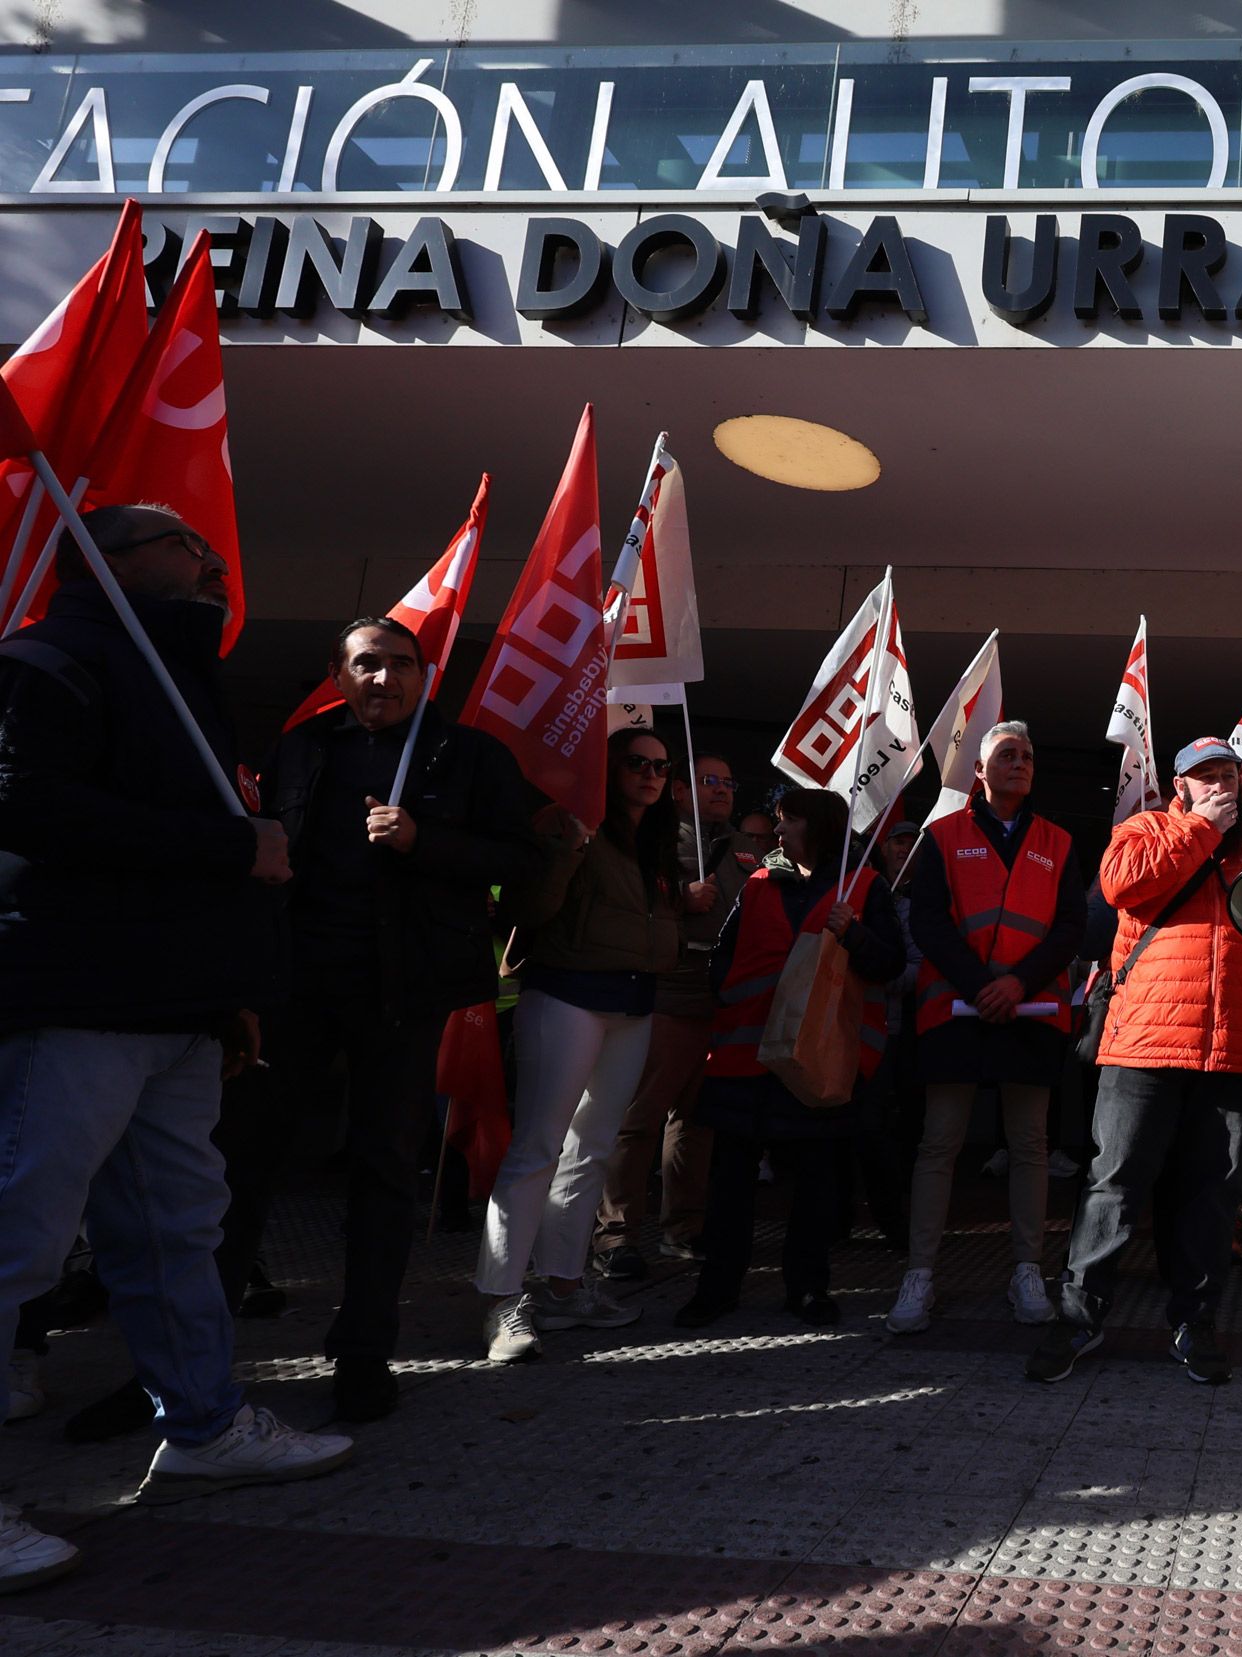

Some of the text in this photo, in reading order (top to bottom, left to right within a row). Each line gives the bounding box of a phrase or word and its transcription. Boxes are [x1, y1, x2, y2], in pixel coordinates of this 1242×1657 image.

[0, 58, 615, 193] ACIÓN
[516, 191, 926, 324] DOÑA
[956, 847, 988, 857] CCOO
[1026, 850, 1054, 867] CCOO
